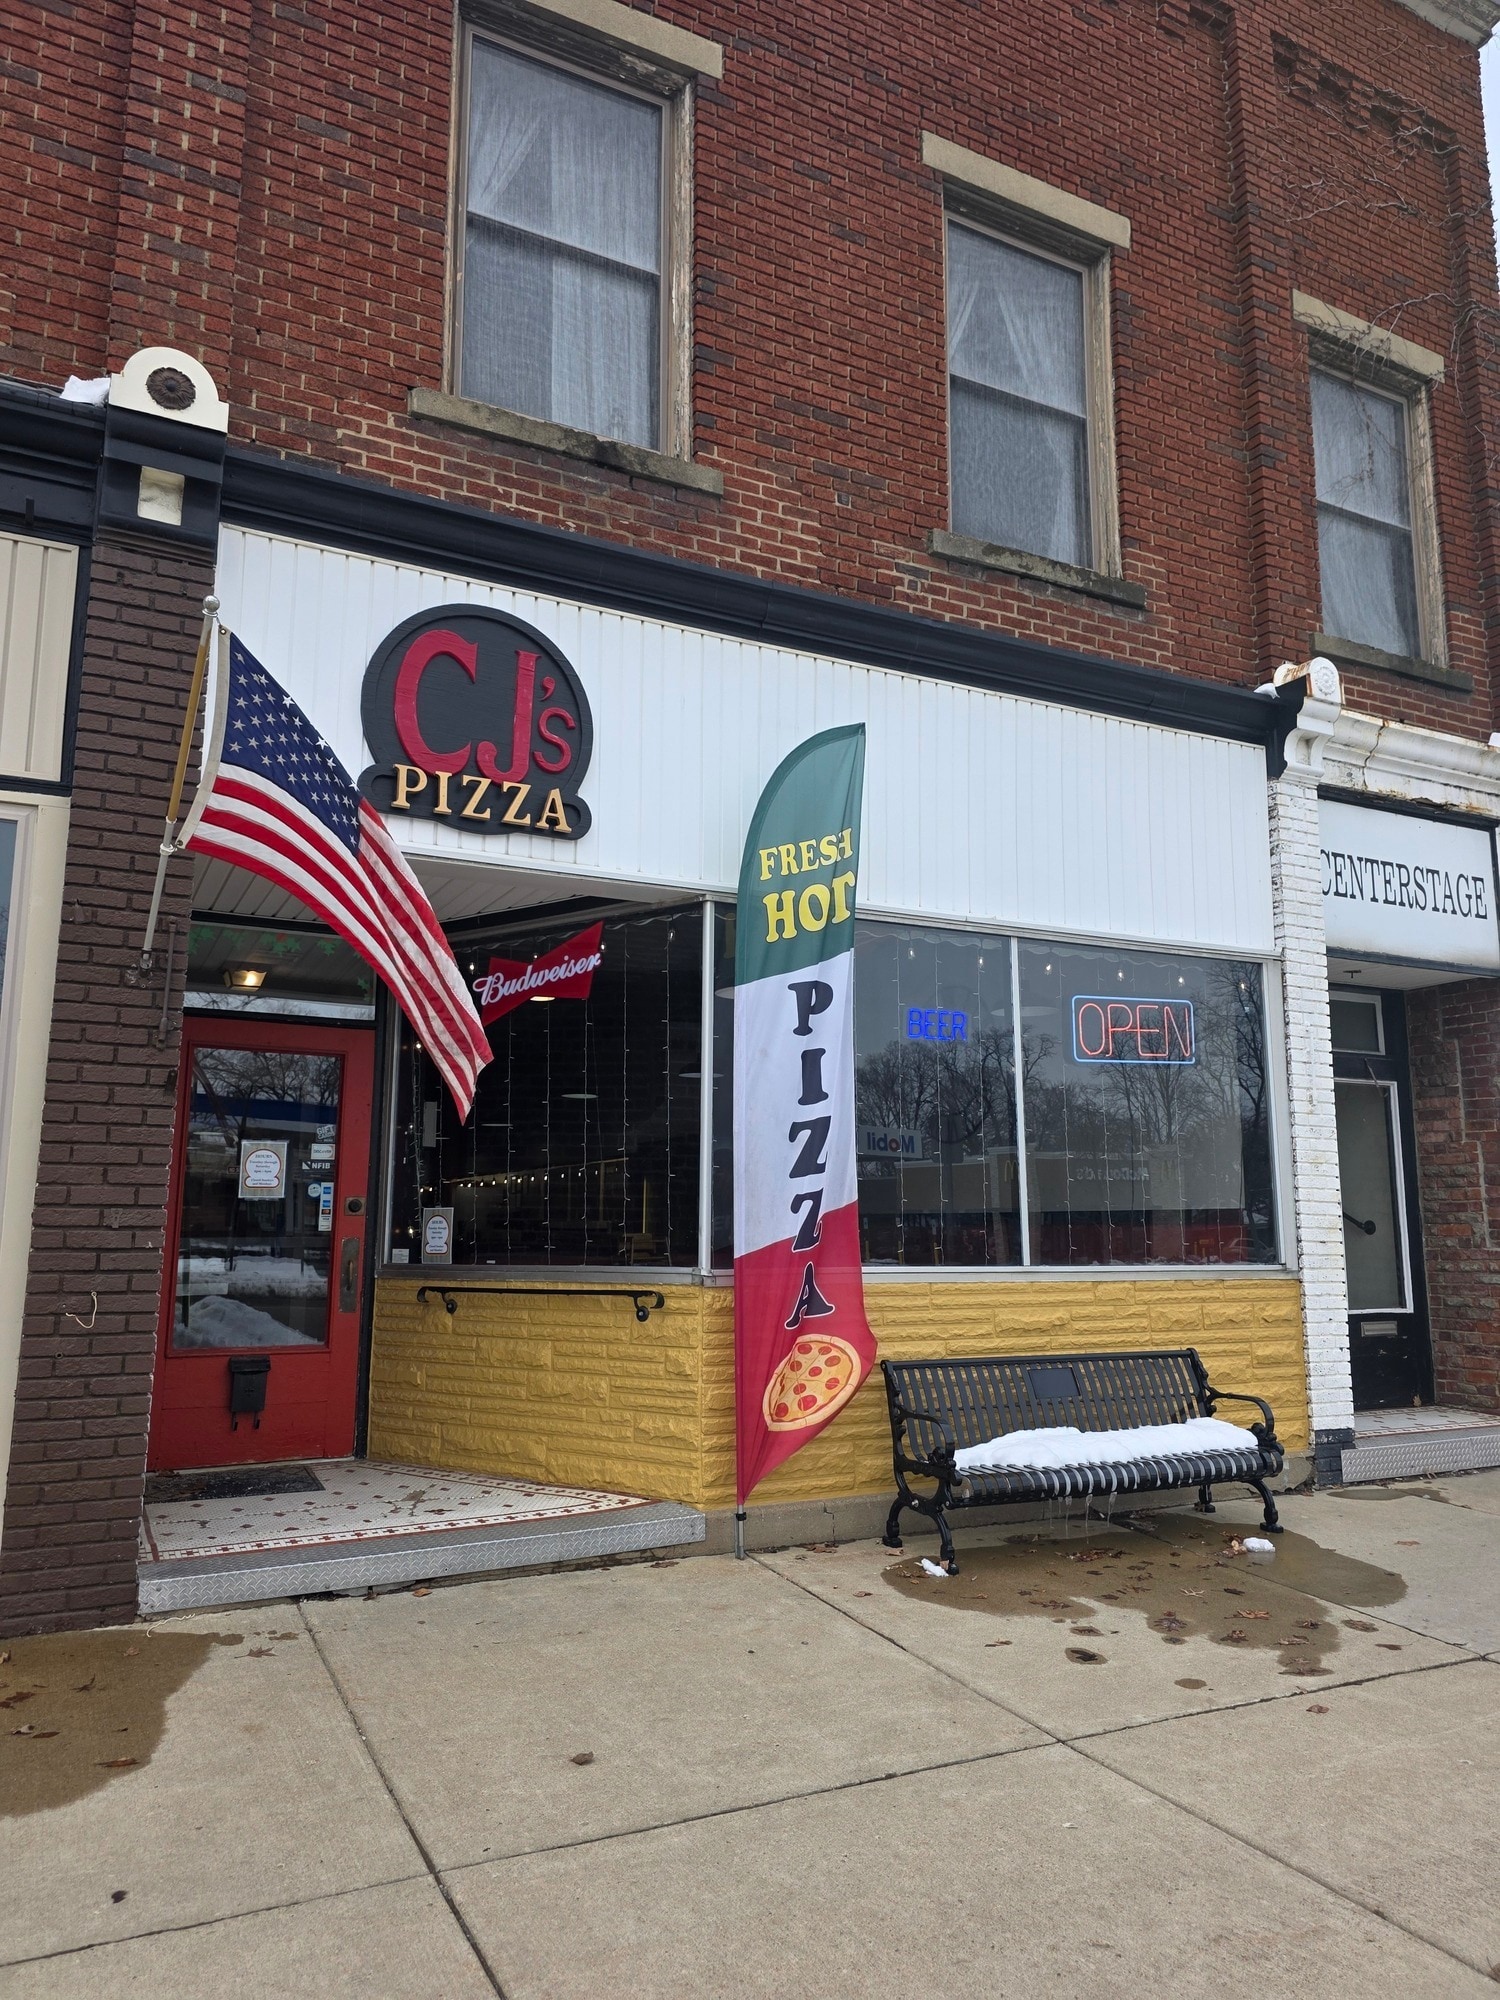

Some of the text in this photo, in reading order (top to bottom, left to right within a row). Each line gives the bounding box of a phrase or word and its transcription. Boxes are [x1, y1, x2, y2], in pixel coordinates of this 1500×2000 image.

[393, 629, 577, 785] CJ's
[390, 763, 573, 834] PIZZA
[758, 827, 854, 881] FRESH
[762, 870, 856, 943] HOT
[472, 952, 602, 1006] Budweiser
[906, 1007, 968, 1042] BEER
[1077, 1002, 1191, 1058] OPEN
[316, 1124, 335, 1136] GIFT
[784, 979, 836, 1330] PIZZA
